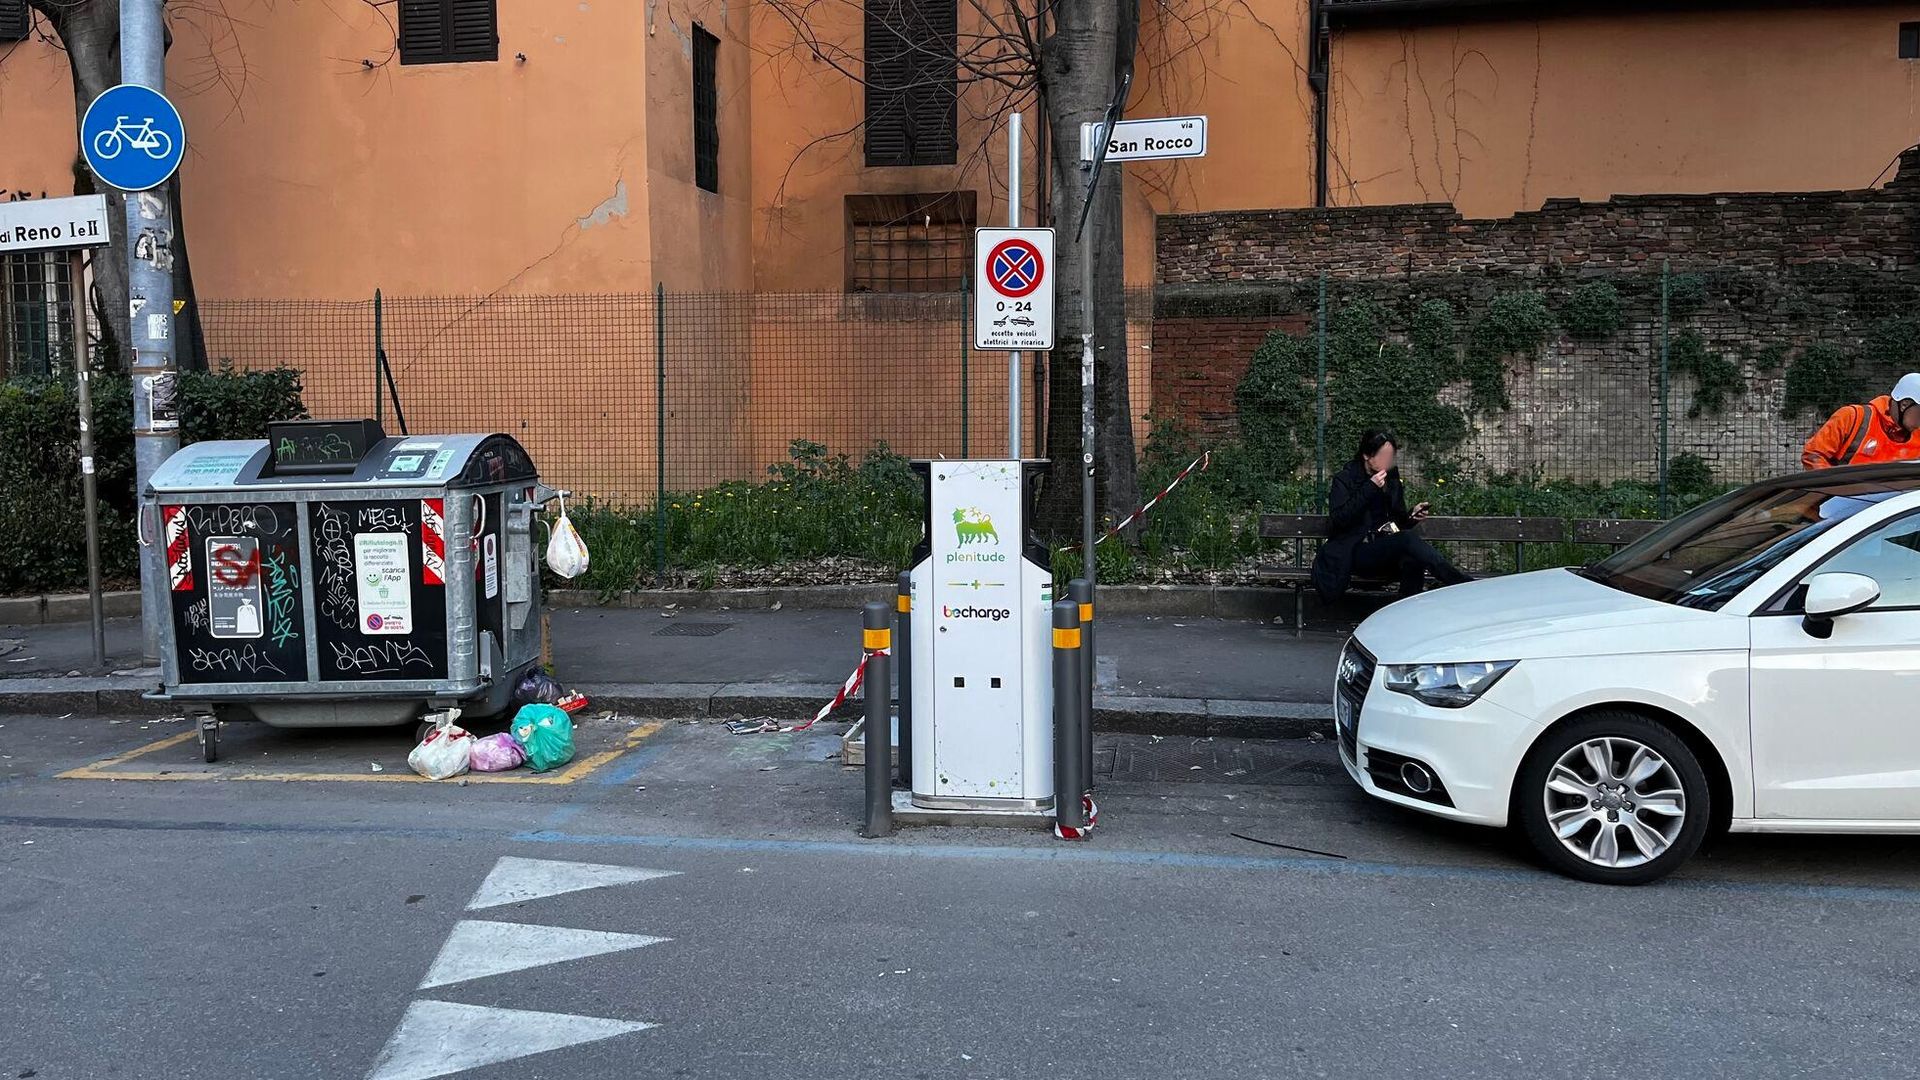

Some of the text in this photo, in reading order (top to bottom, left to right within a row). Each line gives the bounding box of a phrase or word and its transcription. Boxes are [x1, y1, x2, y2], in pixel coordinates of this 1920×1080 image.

[1181, 121, 1193, 129] via
[1108, 137, 1193, 153] San Rocco
[0, 231, 11, 243] di
[15, 226, 62, 242] Reno
[69, 222, 76, 237] I
[78, 227, 86, 236] e
[946, 551, 1006, 564] plenitude
[384, 574, 401, 582] l'App
[943, 605, 1010, 621] becharge
